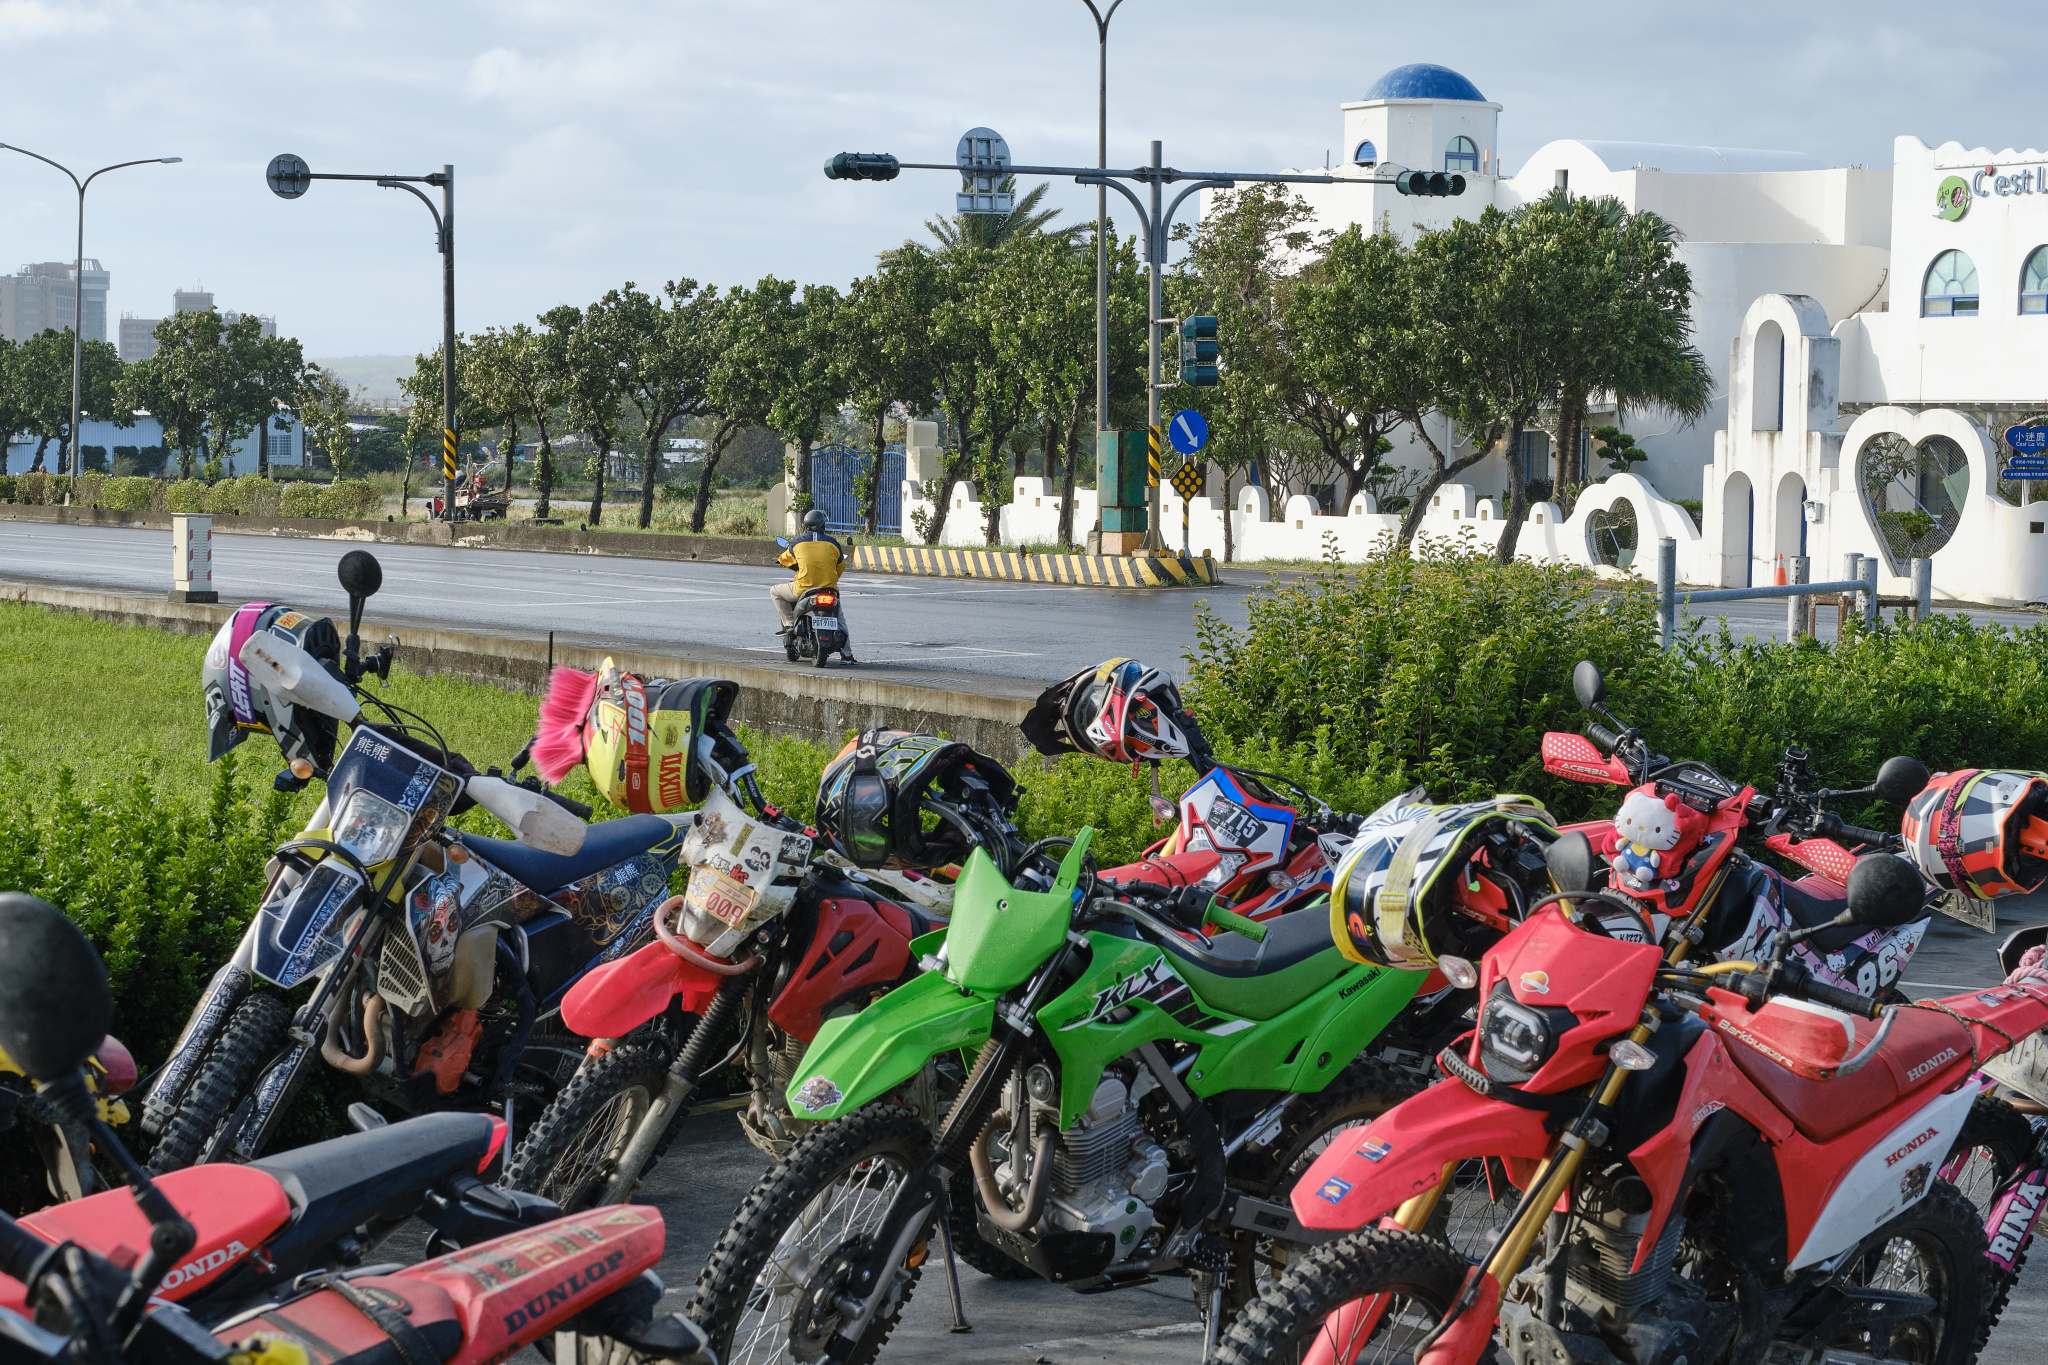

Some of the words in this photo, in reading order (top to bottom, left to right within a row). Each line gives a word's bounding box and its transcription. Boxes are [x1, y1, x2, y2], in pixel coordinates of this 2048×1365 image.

[229, 656, 253, 720] LEATT
[1561, 763, 1610, 777] ACERBIS
[1225, 806, 1259, 839] 715
[1866, 929, 1883, 949] Hell
[1090, 954, 1166, 1020] KLX
[1338, 966, 1381, 1000] Kawasaki
[1857, 944, 1899, 998] 86
[1717, 1018, 1795, 1068] Barkbusters
[1906, 1047, 1959, 1082] HONDA
[1885, 1127, 1939, 1169] HONDA
[1988, 1181, 2048, 1262] RINA
[503, 1248, 626, 1336] DUNLOP
